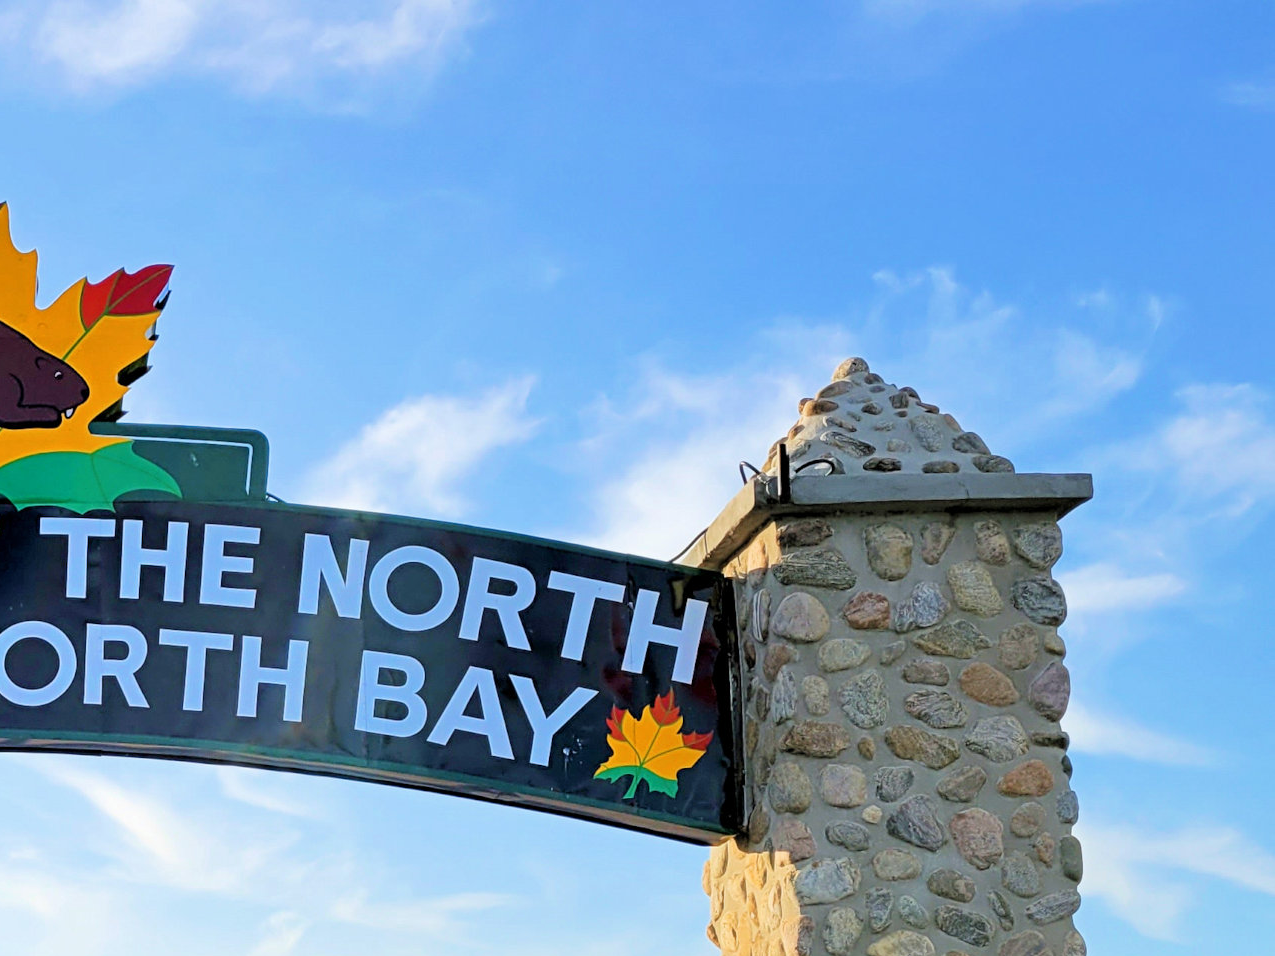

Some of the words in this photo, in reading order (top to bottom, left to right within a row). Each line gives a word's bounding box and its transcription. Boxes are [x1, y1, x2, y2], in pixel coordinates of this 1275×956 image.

[39, 516, 261, 609] THE
[297, 532, 709, 685] NORTH
[354, 650, 600, 767] BAY
